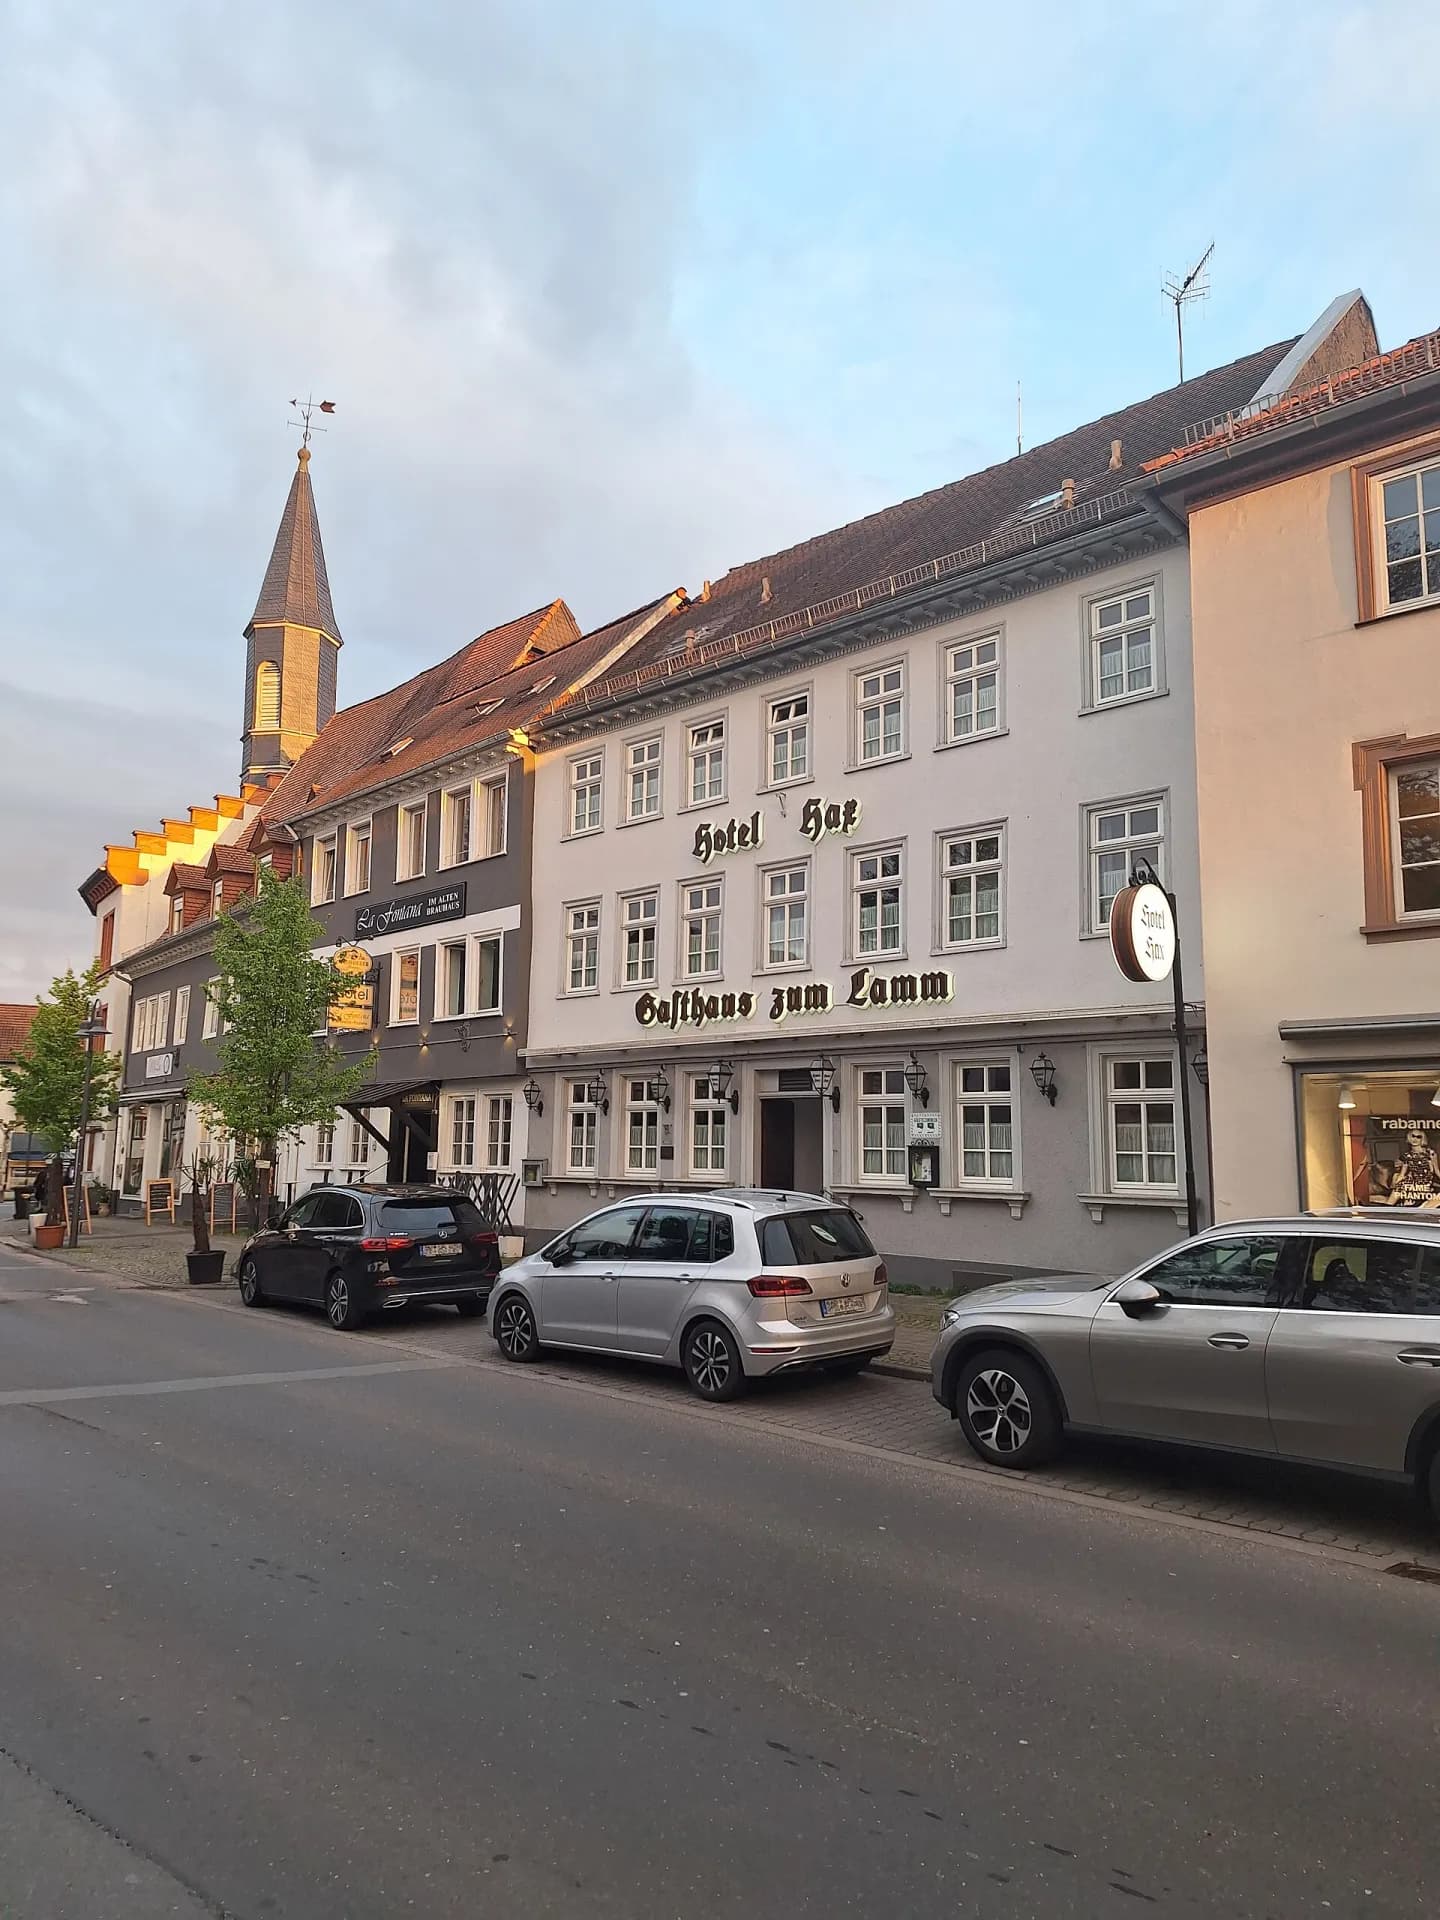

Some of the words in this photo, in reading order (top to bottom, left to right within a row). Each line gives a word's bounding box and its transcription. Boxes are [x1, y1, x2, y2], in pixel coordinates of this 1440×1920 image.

[692, 811, 760, 864] Hotel
[799, 798, 858, 842] Hax
[426, 901, 460, 915] BRAUHAUS
[428, 898, 437, 906] IM
[439, 892, 459, 904] ALTEN
[357, 908, 375, 930] La
[377, 901, 423, 931] Fontana
[1141, 904, 1166, 930] Hotel
[1145, 936, 1165, 960] Hax
[338, 988, 369, 1001] otel
[769, 983, 829, 1020] zum
[847, 967, 949, 1005] Lamm
